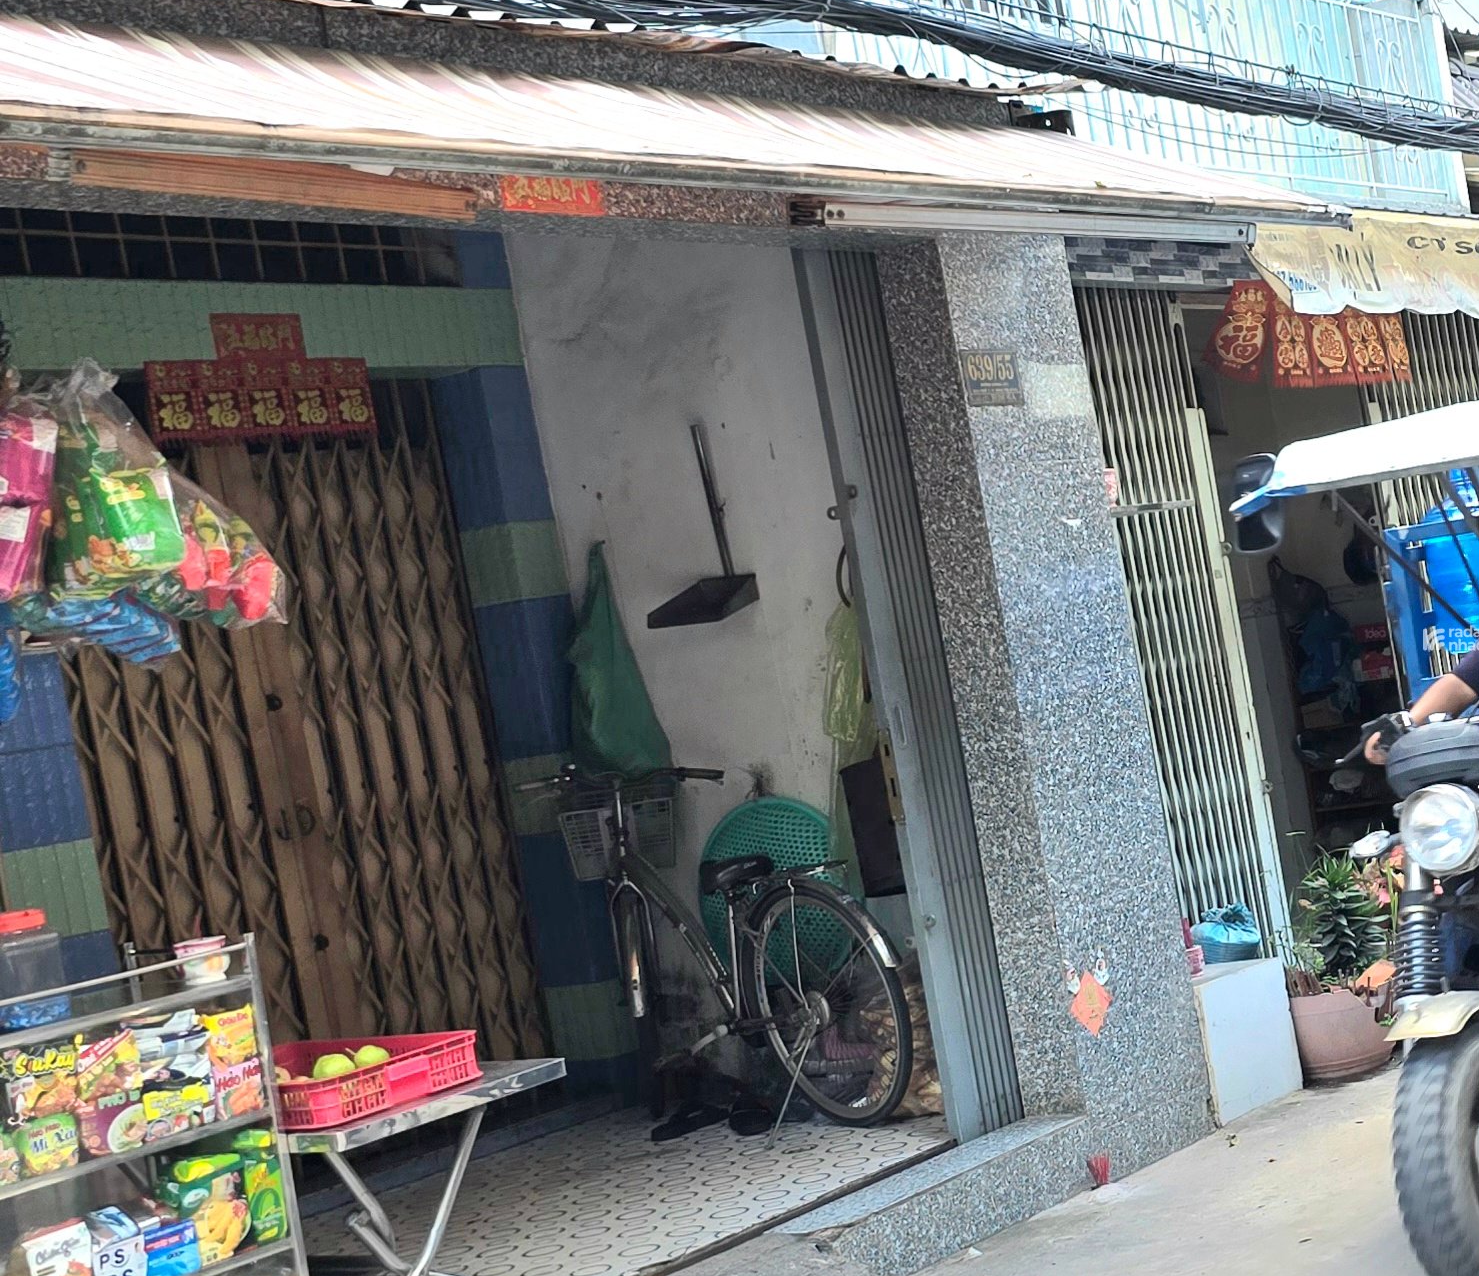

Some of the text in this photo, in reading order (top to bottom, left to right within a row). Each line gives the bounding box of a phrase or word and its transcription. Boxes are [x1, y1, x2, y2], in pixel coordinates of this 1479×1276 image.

[967, 353, 1015, 381] 639/55
[159, 389, 369, 430] 福 福 福 福 福
